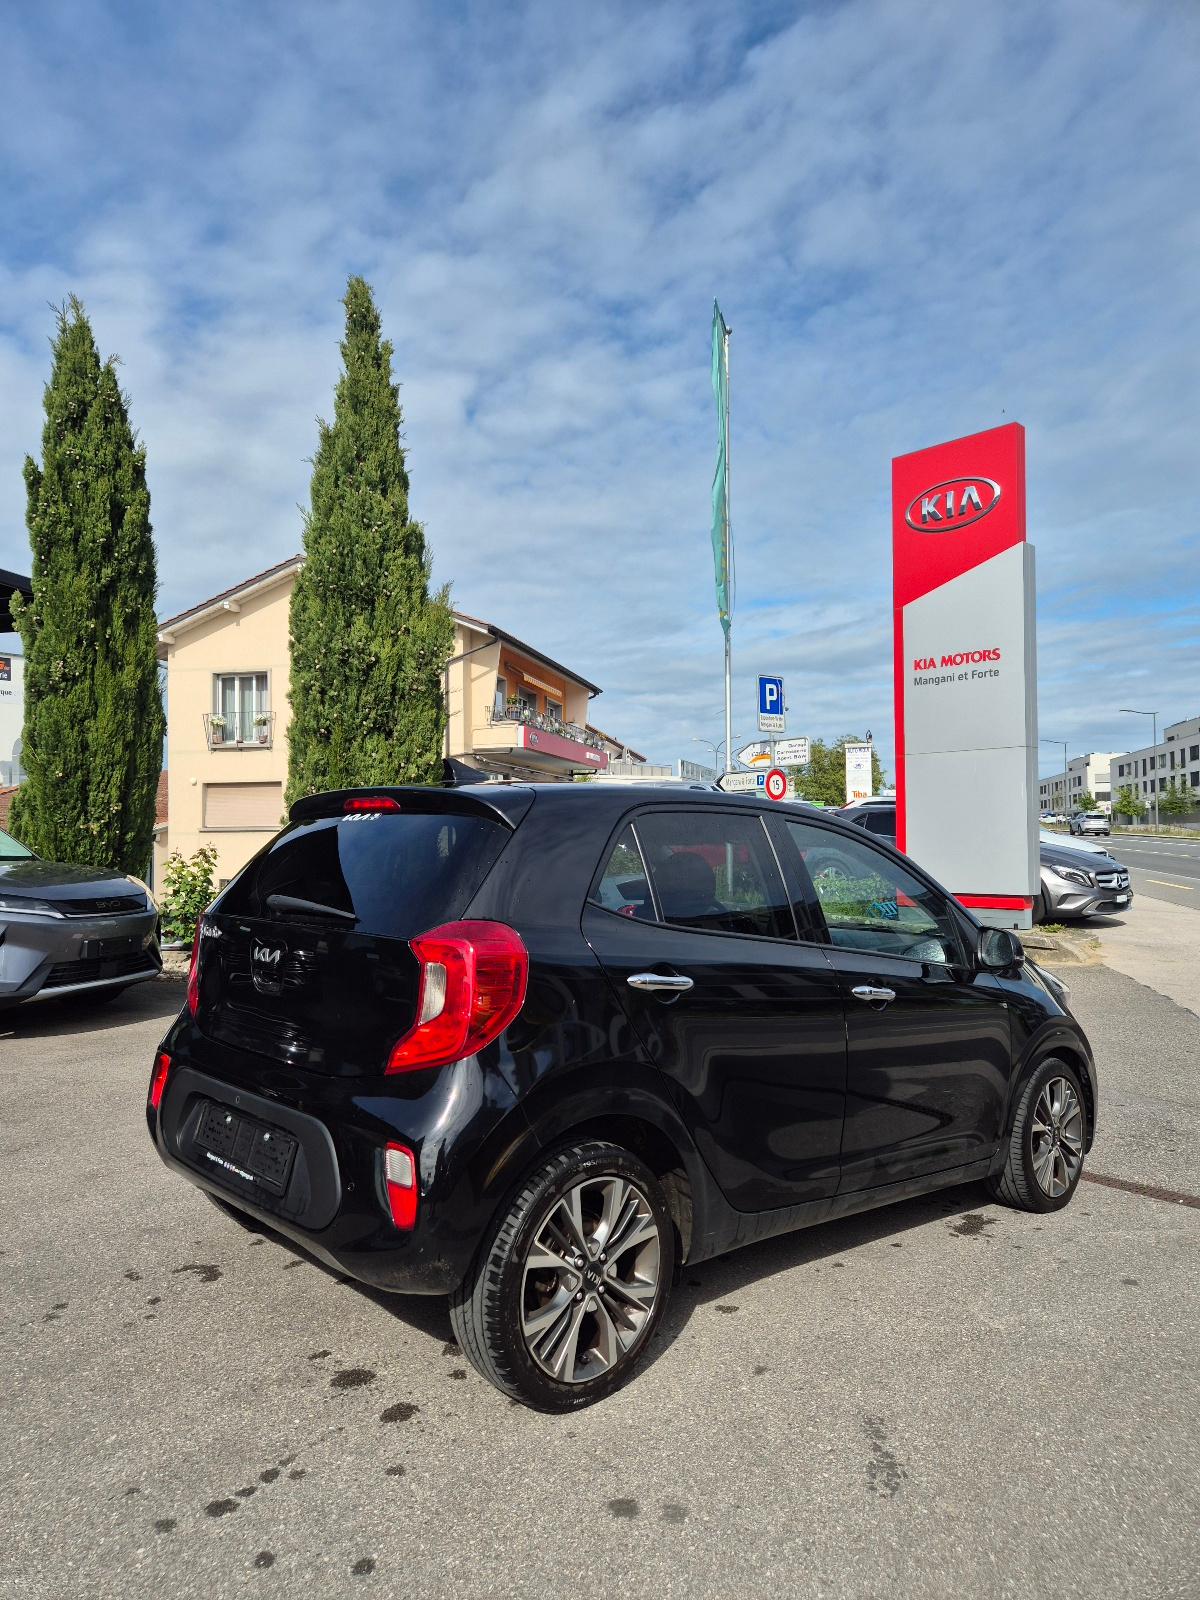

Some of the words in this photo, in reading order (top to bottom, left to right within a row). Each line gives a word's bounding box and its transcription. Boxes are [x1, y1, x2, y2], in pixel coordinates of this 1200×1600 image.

[921, 485, 983, 524] KIA
[913, 657, 937, 671] KIA
[940, 648, 1001, 668] MOTORS
[913, 672, 955, 687] Mangani
[957, 670, 969, 681] et
[971, 668, 1000, 680] Forte
[765, 683, 778, 710] P
[772, 779, 780, 791] 15
[851, 790, 868, 799] Tiba
[253, 946, 281, 963] KIA
